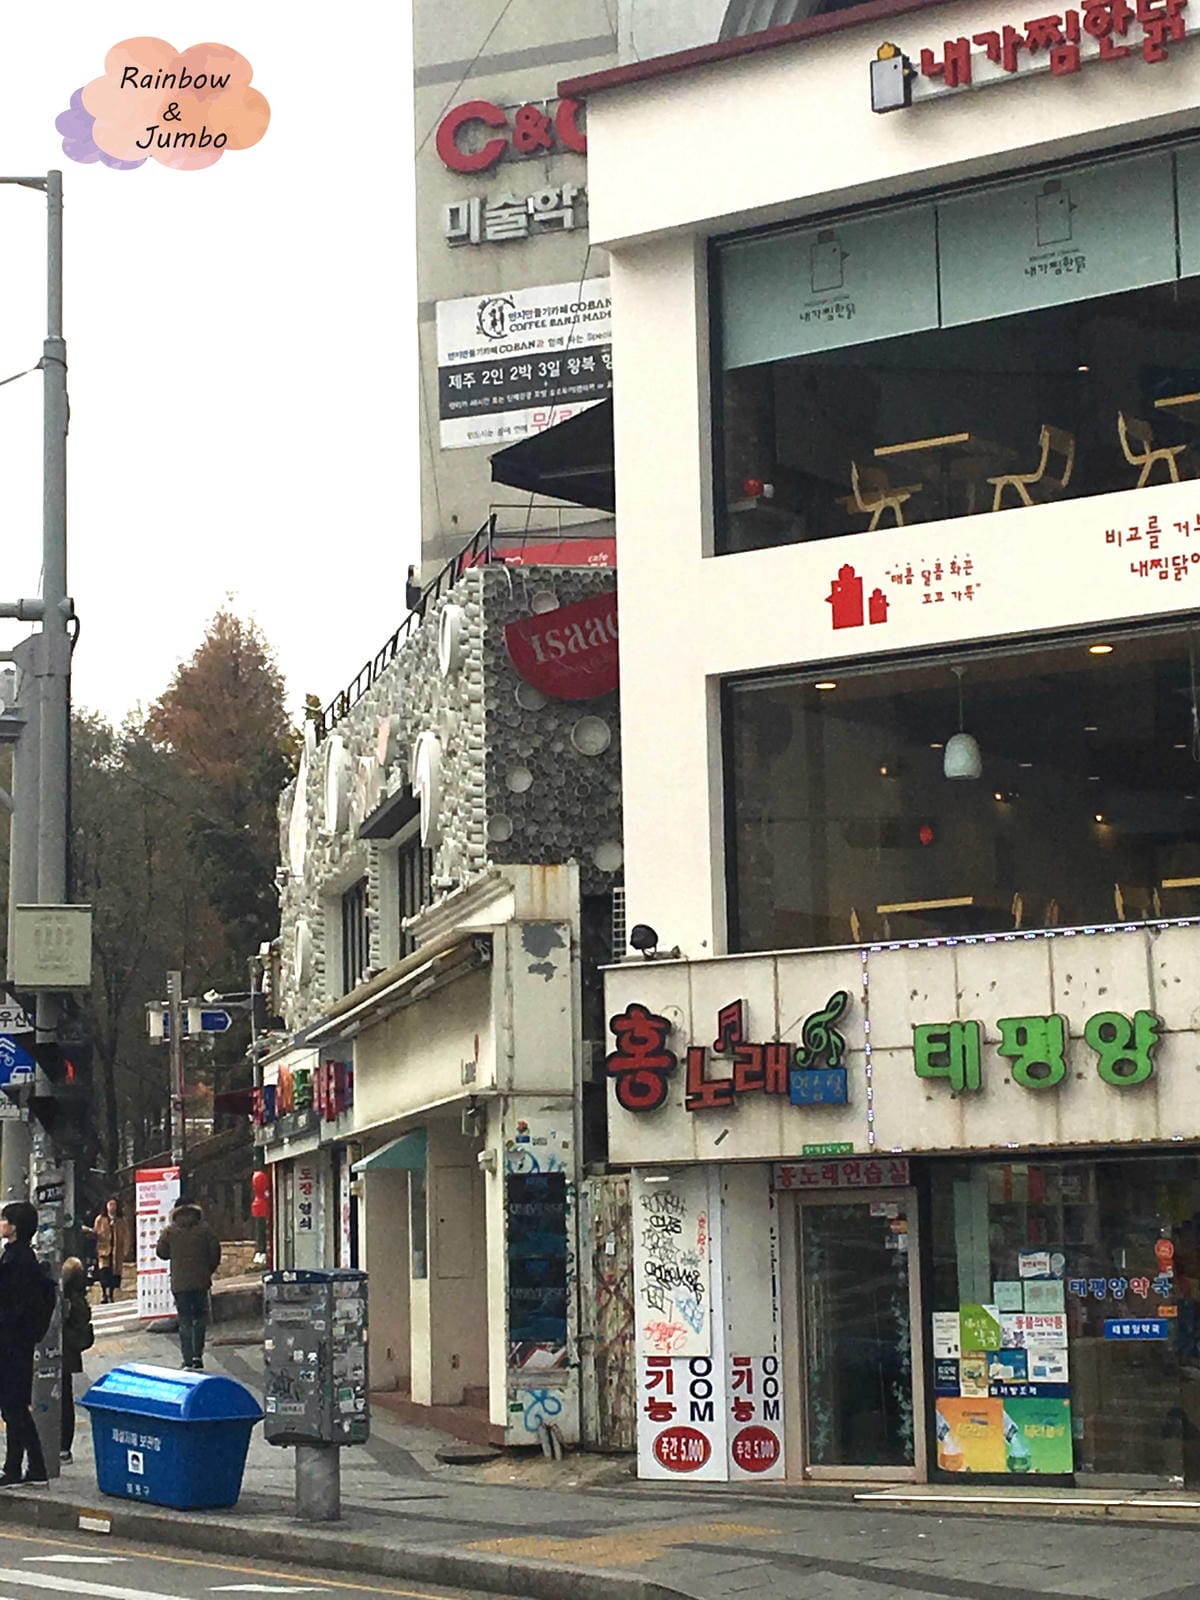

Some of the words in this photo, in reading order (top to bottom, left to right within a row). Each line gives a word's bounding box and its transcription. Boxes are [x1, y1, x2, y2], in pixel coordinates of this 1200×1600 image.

[445, 182, 588, 245] 미술학
[448, 372, 476, 390] 제주
[482, 368, 504, 385] 2인
[510, 364, 533, 380] 2박
[538, 360, 561, 377] 3일
[567, 355, 596, 375] 왕복
[1105, 515, 1162, 550] 비교를
[913, 1010, 1160, 1091] 태평양
[1068, 1277, 1173, 1300] 태평양약국
